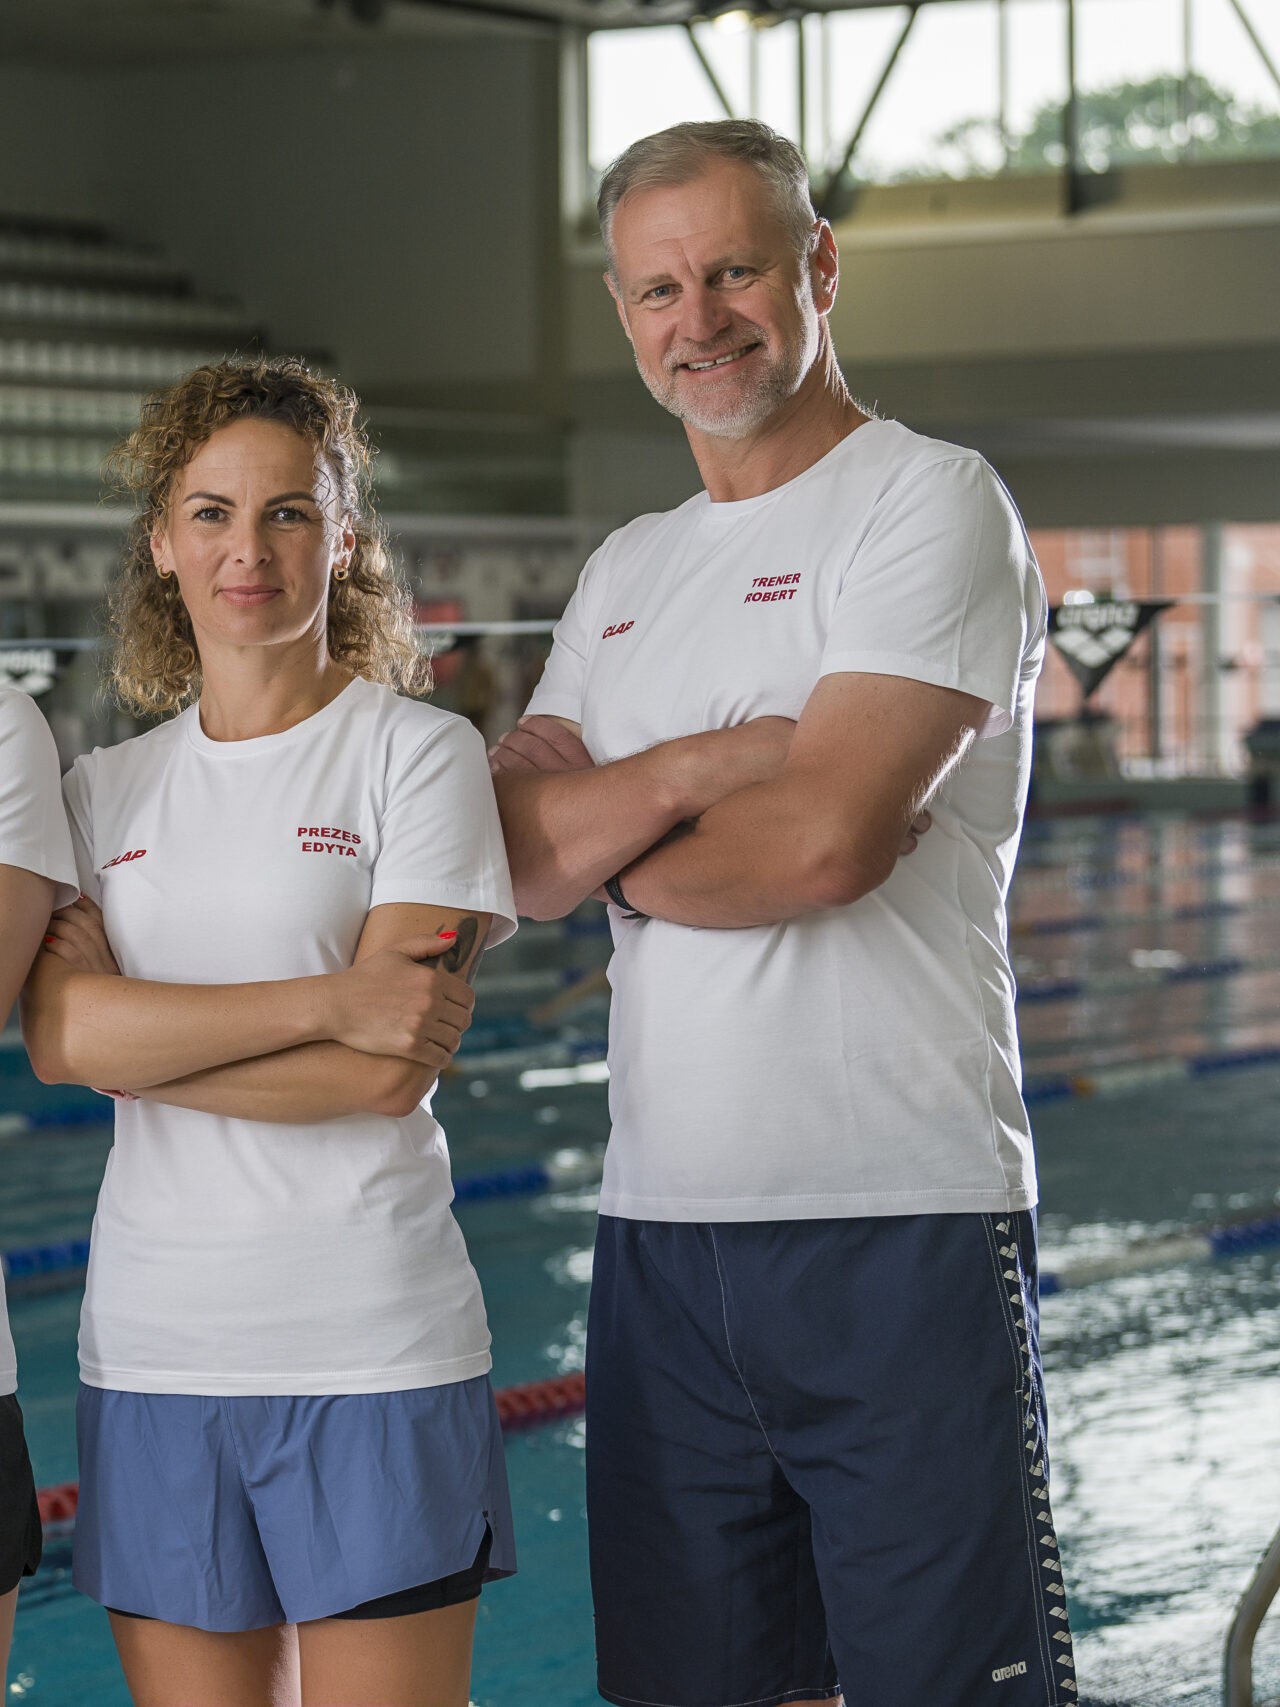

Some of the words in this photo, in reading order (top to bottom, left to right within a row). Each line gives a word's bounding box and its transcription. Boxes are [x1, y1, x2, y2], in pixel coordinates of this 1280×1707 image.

[751, 572, 802, 588] TRENER
[743, 588, 798, 603] ROBERT
[297, 826, 362, 845] PREZES
[301, 841, 358, 857] EDYTA
[991, 1660, 1027, 1683] arena
